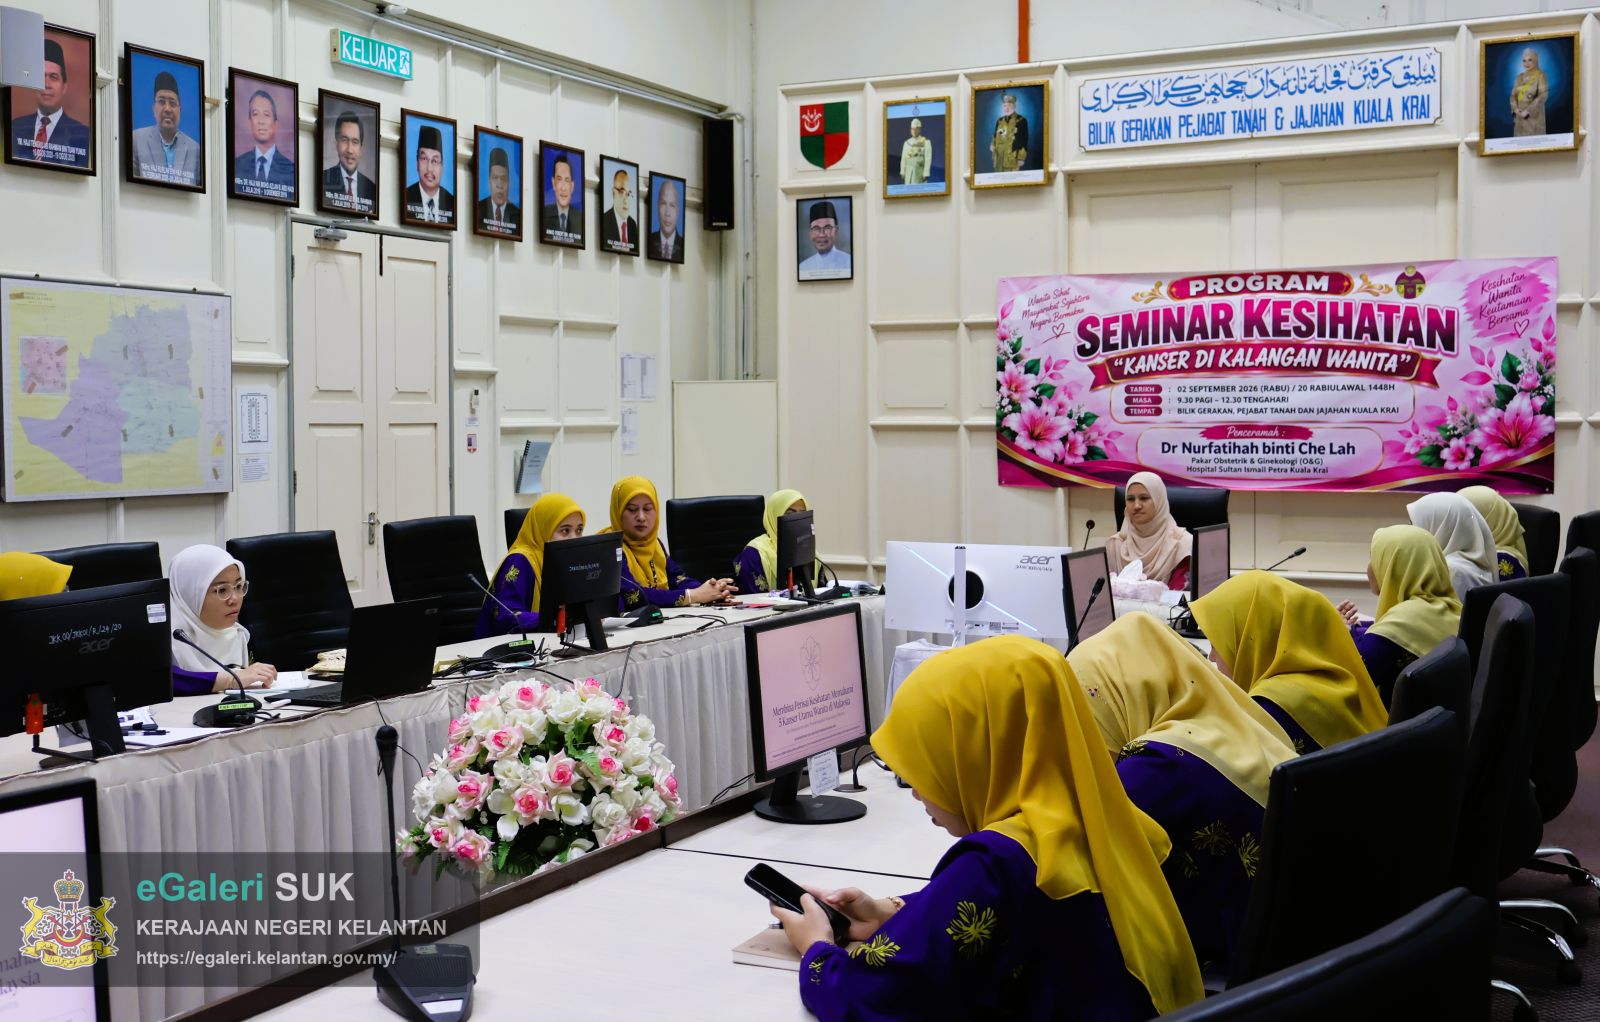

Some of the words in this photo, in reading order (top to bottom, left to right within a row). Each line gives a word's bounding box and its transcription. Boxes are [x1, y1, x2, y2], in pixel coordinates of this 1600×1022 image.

[342, 34, 397, 72] KELUAR
[1088, 121, 1116, 146] BILIK
[1122, 116, 1172, 143] GERAKAN
[1178, 111, 1227, 138] PEJABAT
[1231, 108, 1267, 134] TANAH
[1275, 107, 1284, 131] &
[1290, 101, 1344, 129] JAJAHAN
[1354, 97, 1394, 125] KUALA
[1402, 94, 1430, 120] KRAI
[1189, 274, 1329, 297] PROGRAM
[1481, 272, 1526, 295] Kesihatan
[1488, 284, 1522, 304] Wanita
[1480, 296, 1533, 319] Keutamaan
[1076, 302, 1234, 357] SEMINAR
[1243, 297, 1457, 353] KESIHATAN
[1488, 309, 1529, 330] Bersama
[1194, 350, 1213, 369] DI
[1218, 347, 1322, 368] KALANGAN
[1177, 385, 1186, 393] 02
[1189, 385, 1236, 393] SEPTEMBER
[1260, 385, 1290, 393] (RABU)
[1237, 407, 1268, 415] PEJABAT
[1317, 407, 1350, 415] JAJAHAN
[1226, 425, 1280, 438] Penceramah
[1161, 442, 1178, 454] Dr
[1182, 441, 1259, 454] Nurfatihah
[1262, 442, 1295, 454] binti
[1298, 442, 1326, 455] Che
[1329, 442, 1356, 455] Lah
[1186, 465, 1217, 474] Hospital
[1219, 465, 1242, 473] Sultan
[1244, 465, 1266, 473] Ismail
[1313, 466, 1329, 474] Krai
[1257, 457, 1298, 465] Ginekologi
[1299, 457, 1323, 466] (O&G)
[1019, 555, 1055, 565] acer
[79, 637, 116, 655] acer
